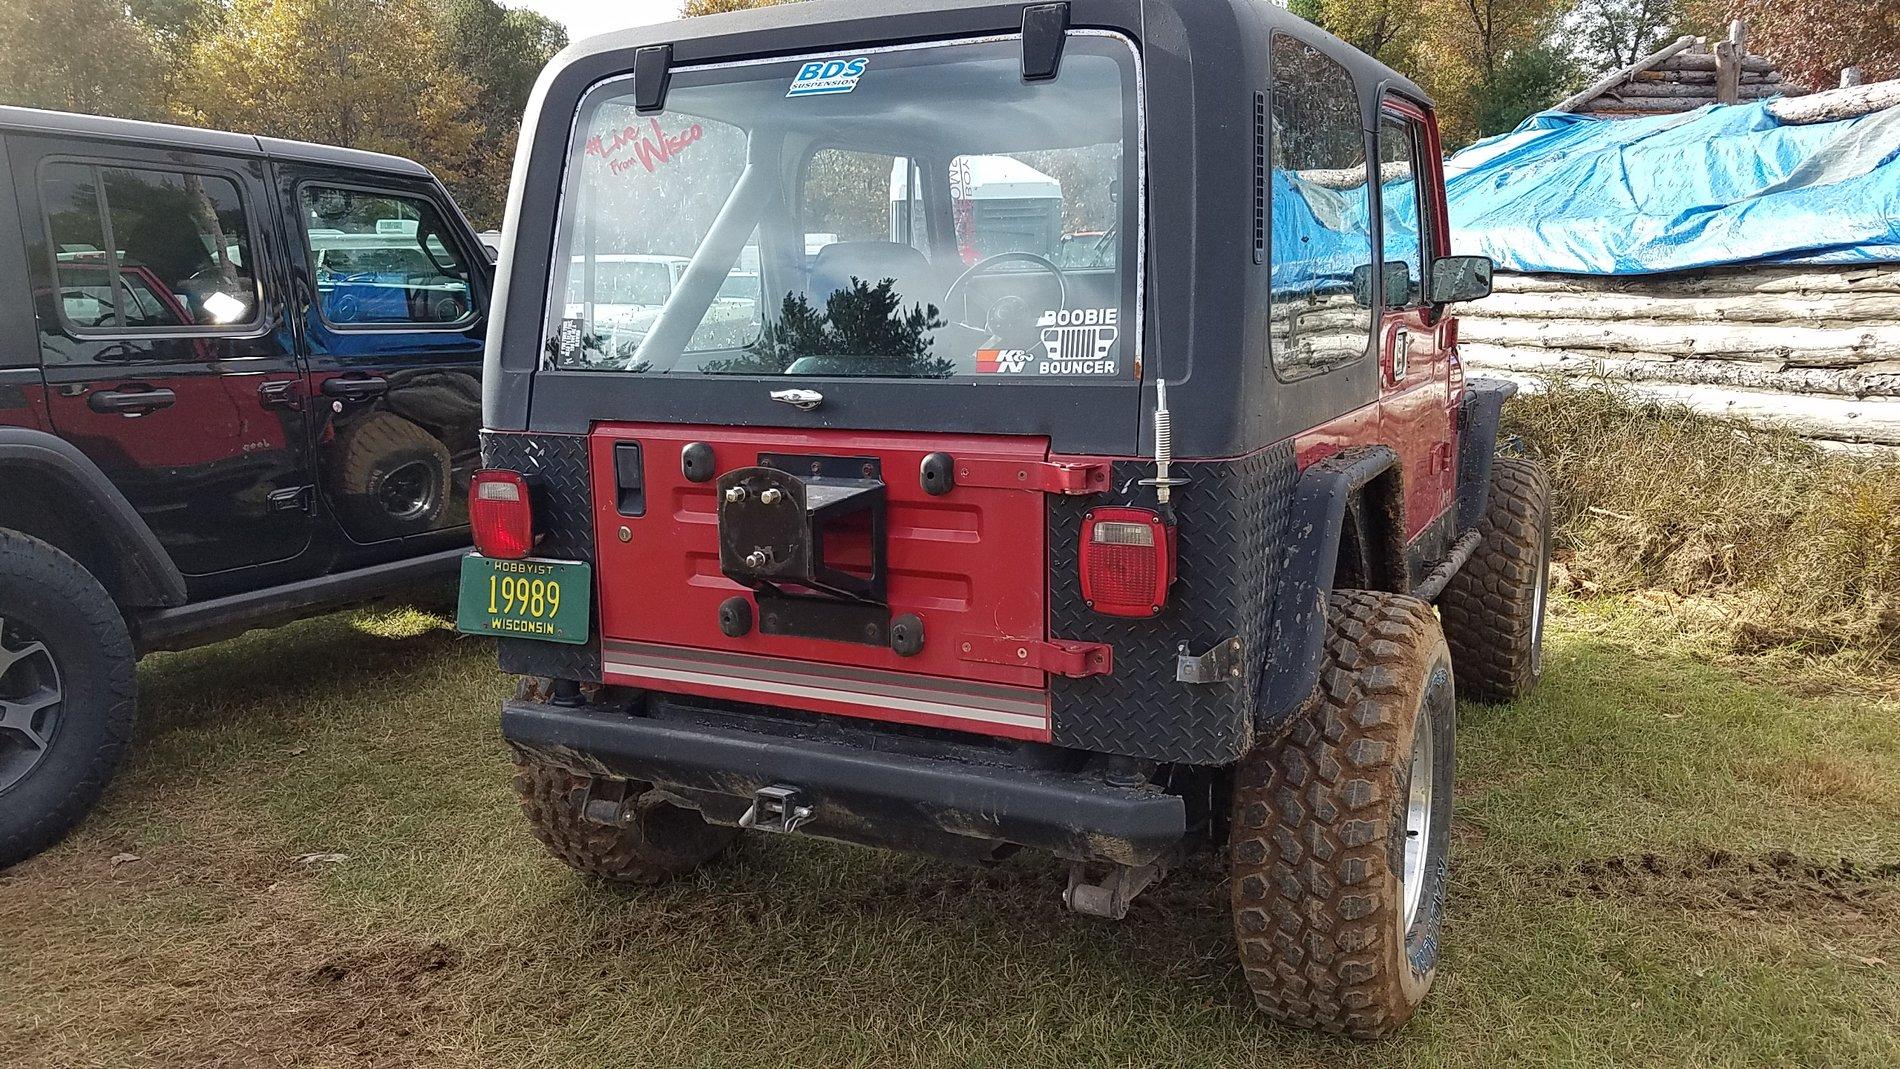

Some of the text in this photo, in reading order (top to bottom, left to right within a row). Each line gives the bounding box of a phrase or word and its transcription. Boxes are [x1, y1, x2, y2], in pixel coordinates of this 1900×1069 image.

[798, 58, 868, 81] BDS
[792, 79, 857, 89] SUSPENSION
[1042, 308, 1118, 326] BOOBIE
[1039, 360, 1115, 374] BOUNCER
[494, 561, 554, 575] HOBBYIST
[487, 575, 561, 618] 19989
[491, 617, 554, 635] WISCONSIN
